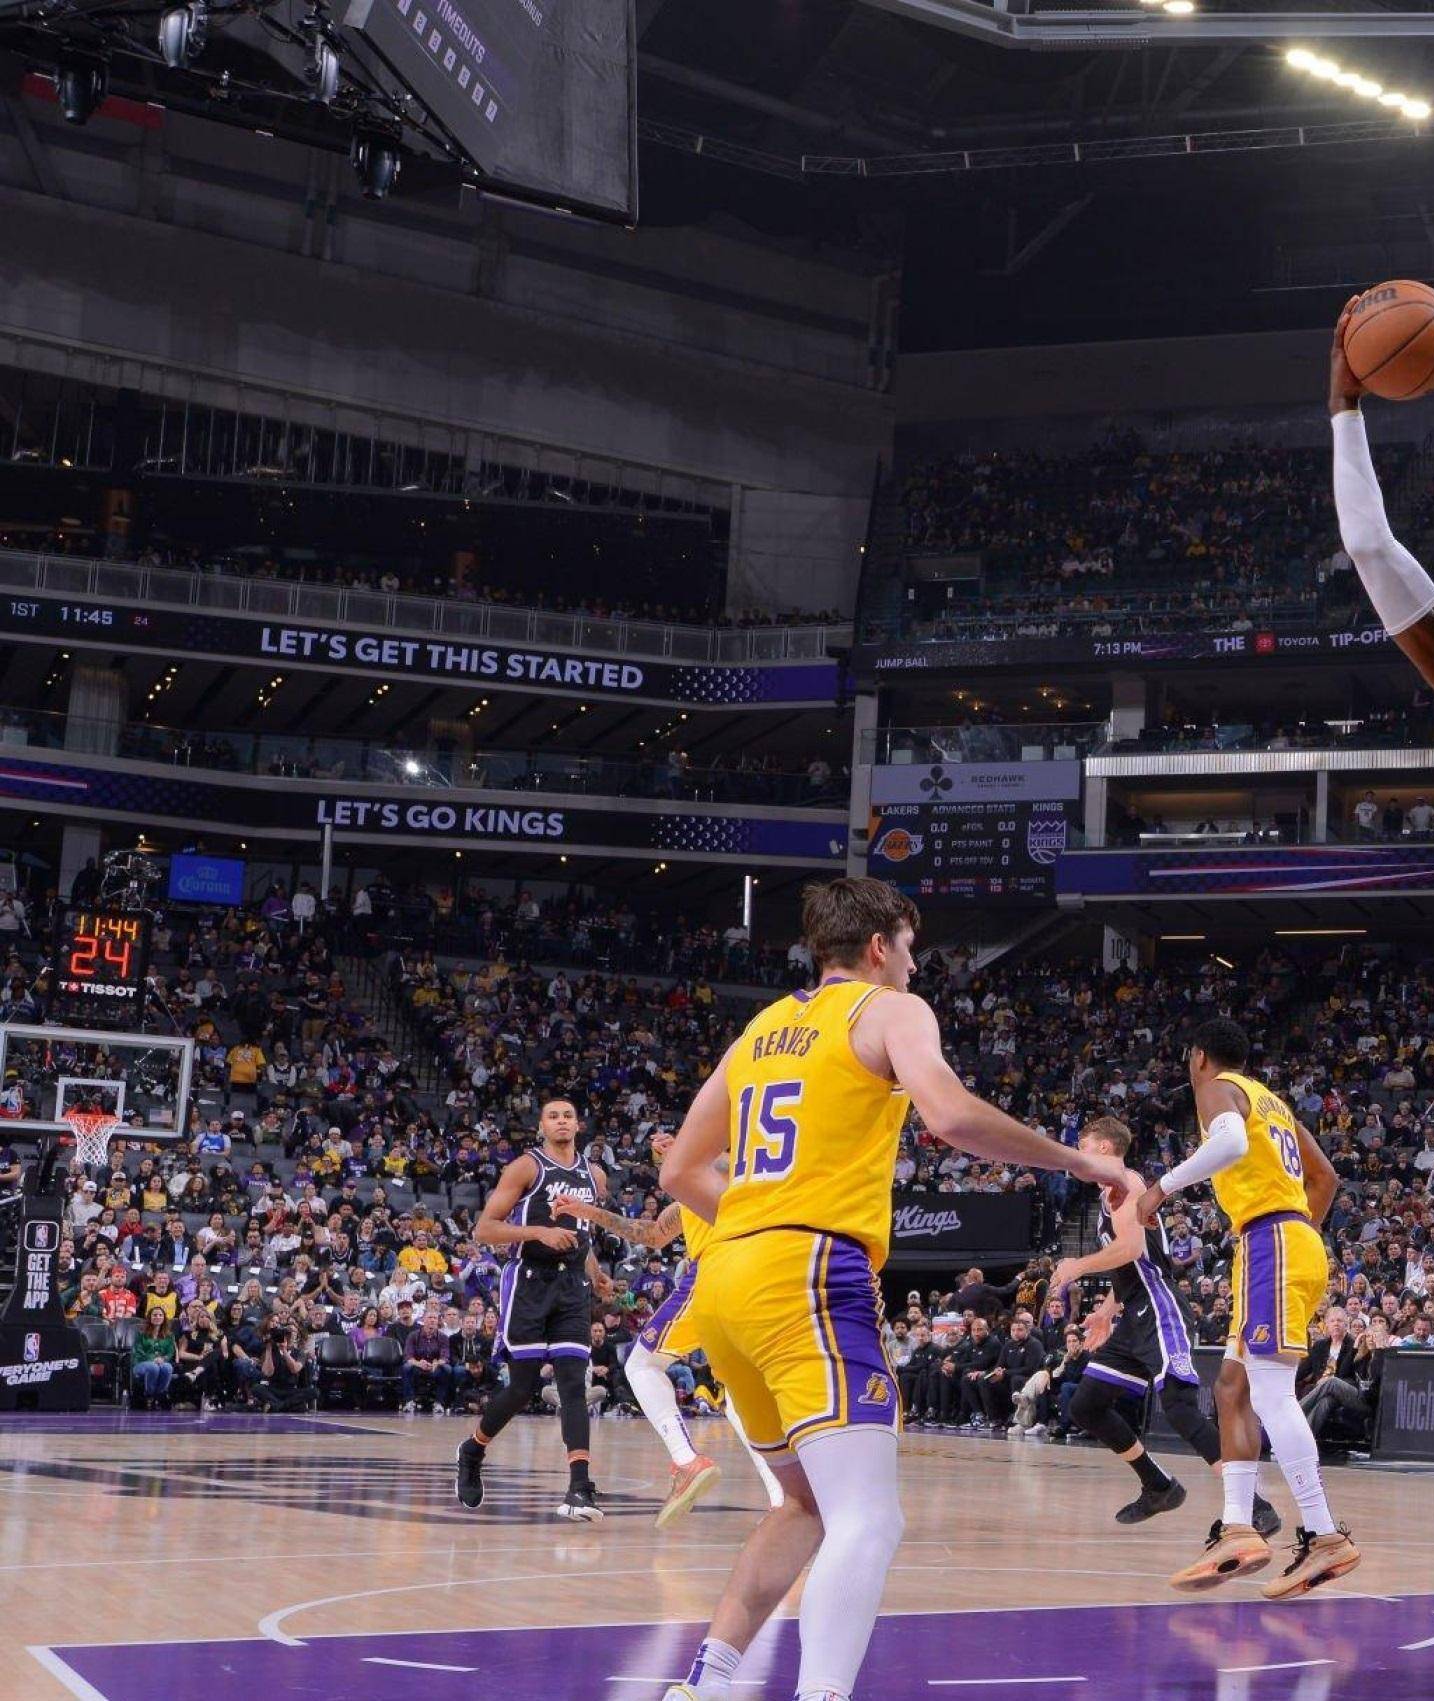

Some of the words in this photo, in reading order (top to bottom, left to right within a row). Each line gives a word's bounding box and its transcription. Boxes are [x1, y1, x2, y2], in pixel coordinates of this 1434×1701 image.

[11, 602, 39, 618] 1ST
[60, 606, 113, 625] 11:45
[134, 616, 148, 626] 24
[1094, 642, 1121, 655] 7:13
[1123, 642, 1142, 654] PM
[1213, 636, 1245, 652] THE
[1278, 637, 1320, 647] TOYOTA
[261, 628, 348, 660] LET'S
[355, 637, 419, 666] GET
[426, 644, 498, 675] THIS
[506, 654, 644, 689] STARTED
[875, 658, 903, 669] JUMP
[905, 657, 928, 668] BALL
[881, 806, 920, 815] LAKERS
[1032, 802, 1064, 812] KINGS
[317, 800, 399, 830] LET'S
[406, 805, 456, 831] GO
[464, 808, 564, 837] KINGS
[931, 823, 948, 834] 0.0
[998, 821, 1016, 832] 0.0
[934, 840, 943, 849] 0
[1002, 838, 1010, 849] 0
[934, 857, 942, 867] 0
[1001, 855, 1009, 865] 0
[77, 914, 137, 940] 11:44
[70, 936, 130, 978] 24
[81, 982, 137, 997] TISSOT
[753, 1026, 820, 1062] REAVES
[733, 1081, 803, 1183] 15
[1269, 1124, 1302, 1178] 28
[893, 1205, 962, 1238] Kings
[28, 1253, 52, 1271] GET
[27, 1272, 50, 1290] THE
[24, 1291, 50, 1309] APP
[7, 1371, 52, 1386] GAME
